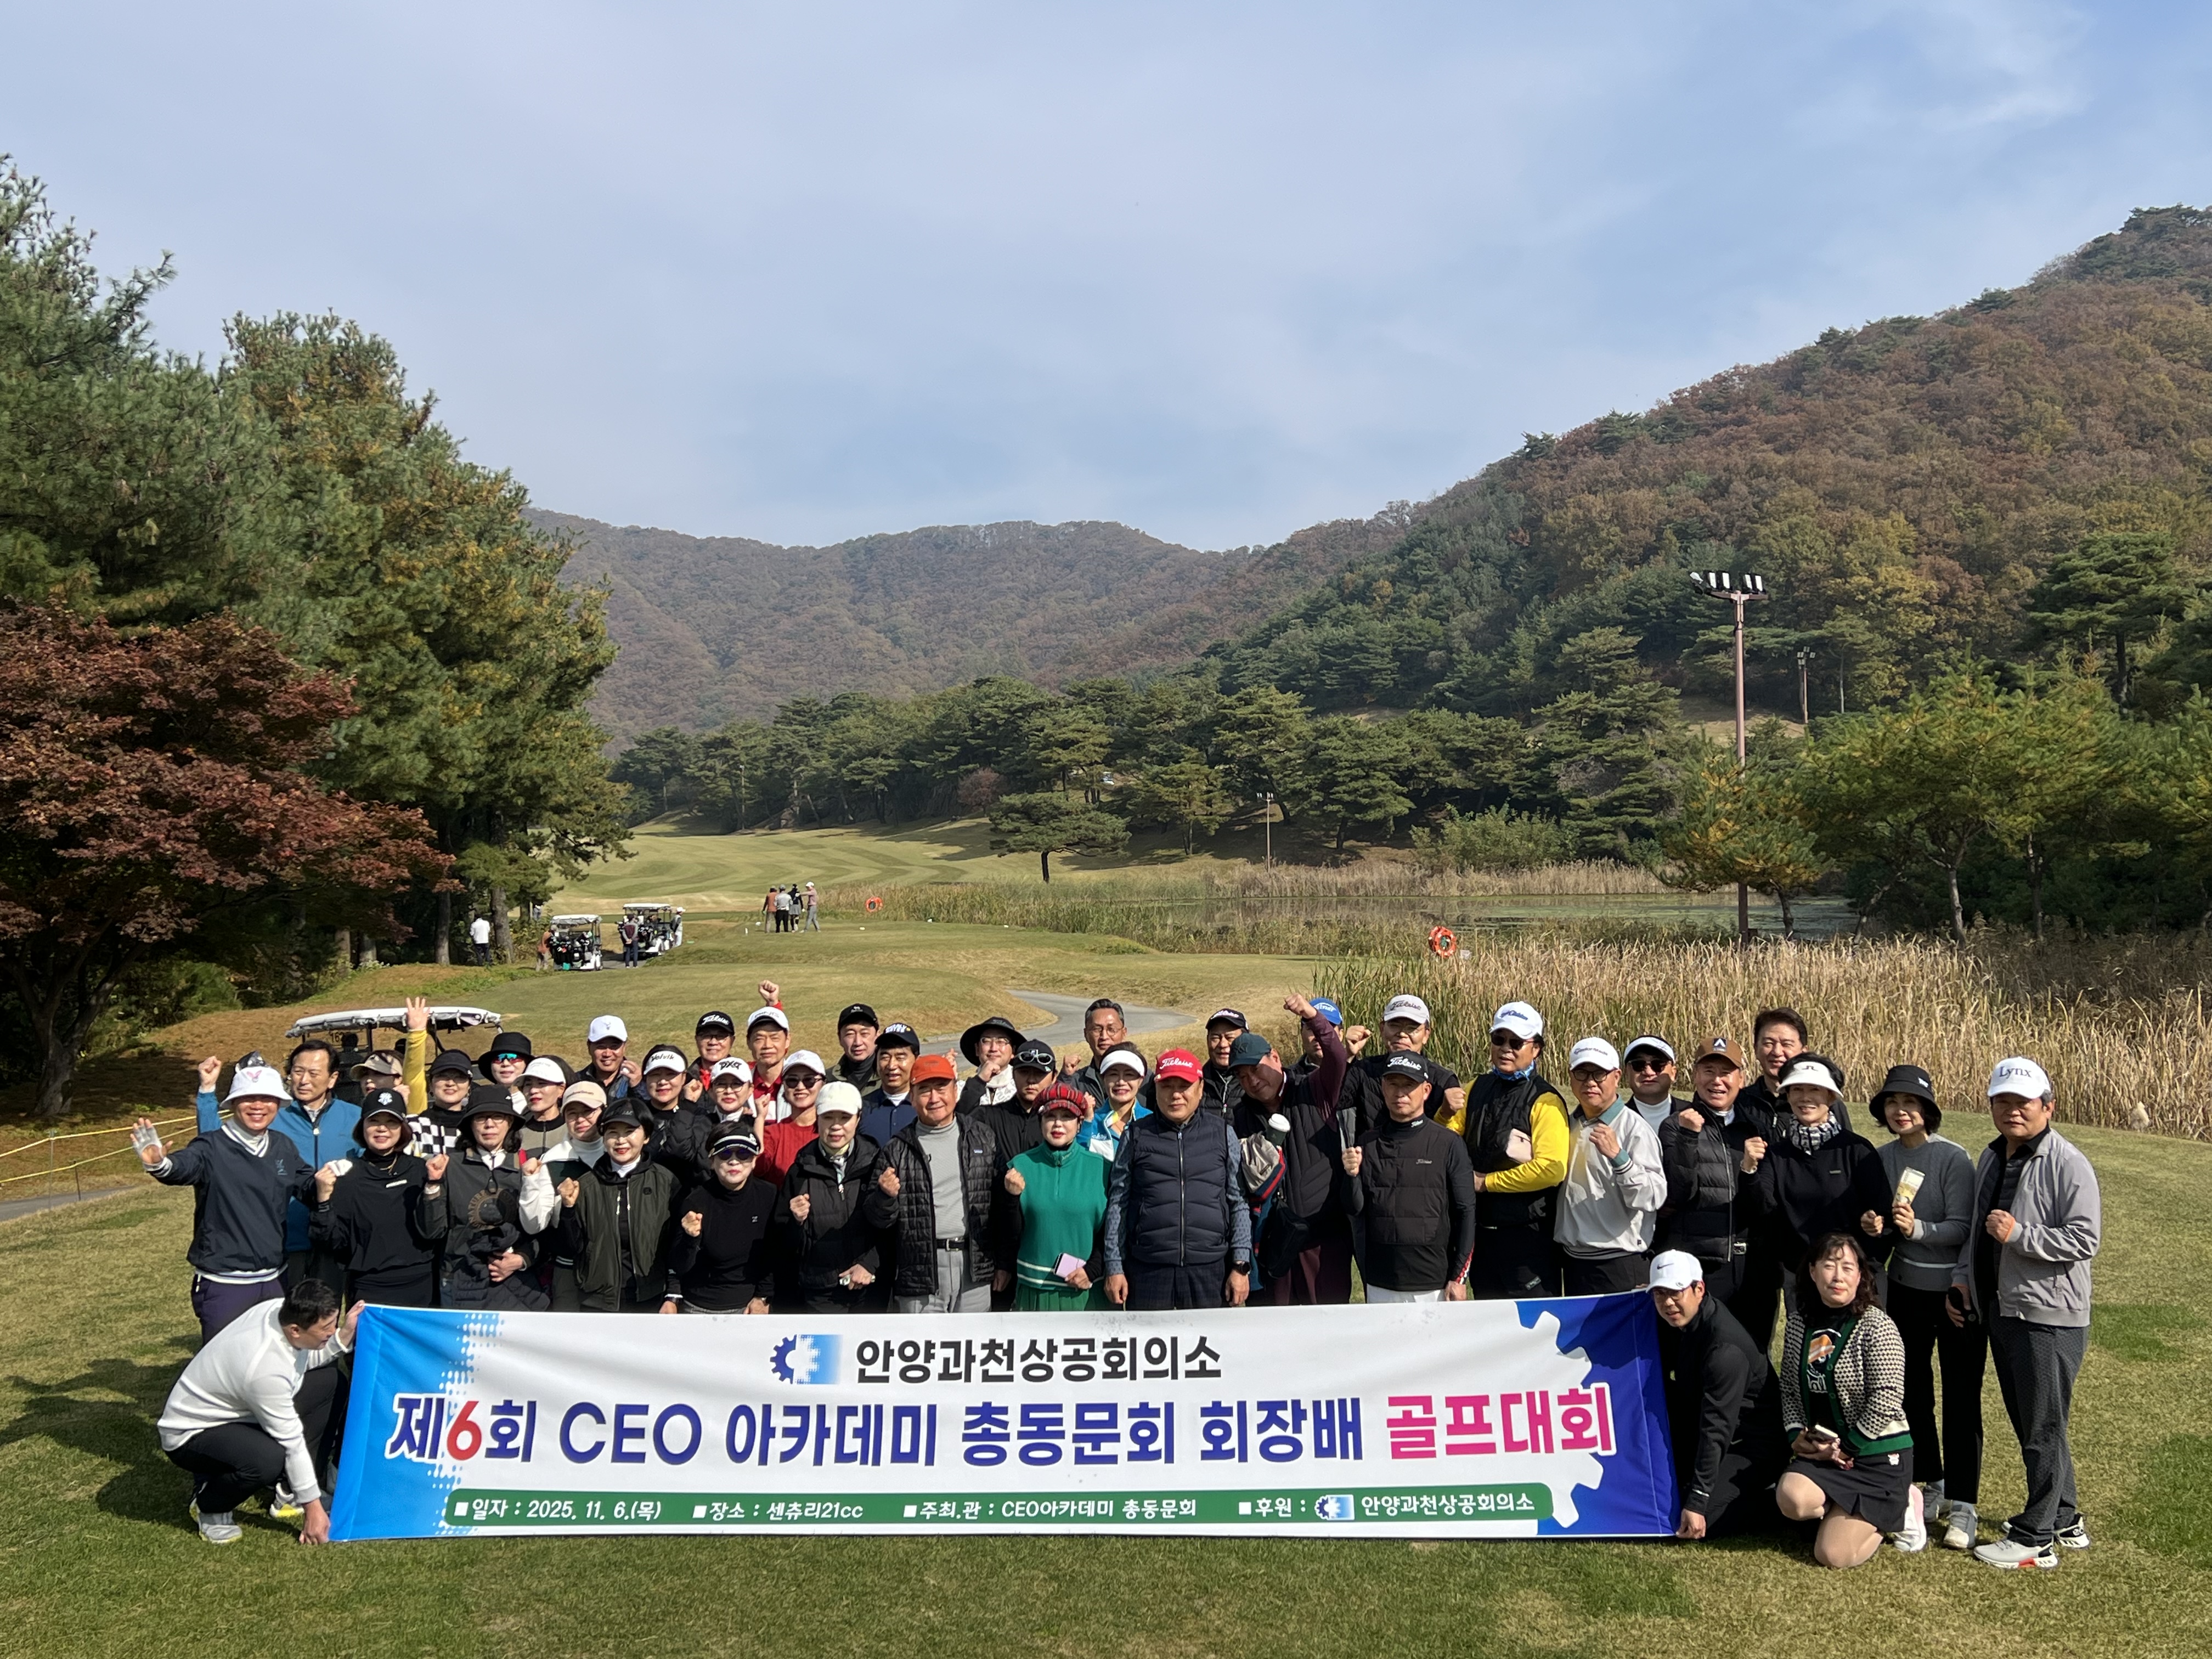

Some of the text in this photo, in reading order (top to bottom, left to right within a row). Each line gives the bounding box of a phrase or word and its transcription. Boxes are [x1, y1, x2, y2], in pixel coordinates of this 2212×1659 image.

[1390, 1000, 1421, 1011] Titleist
[651, 1053, 675, 1063] Volvik
[1160, 1057, 1194, 1070] Titleist
[1387, 1056, 1422, 1070] Titleist
[1999, 1066, 2032, 1079] Lynx
[856, 1336, 1221, 1384] 안양과천상공회의소
[390, 1387, 1612, 1466] 제6회 CEO 아카데미 총동문회 회장배 골프대회
[472, 1499, 508, 1520] 일자
[527, 1500, 577, 1520] 2025.
[709, 1502, 745, 1520] 장소
[766, 1502, 863, 1520] 센츄리21cc
[1002, 1500, 1113, 1517] CEO아카데미
[1122, 1499, 1196, 1519] 총동문회
[1255, 1497, 1291, 1517] 후원
[1361, 1492, 1535, 1516] 안양과천상공회의소
